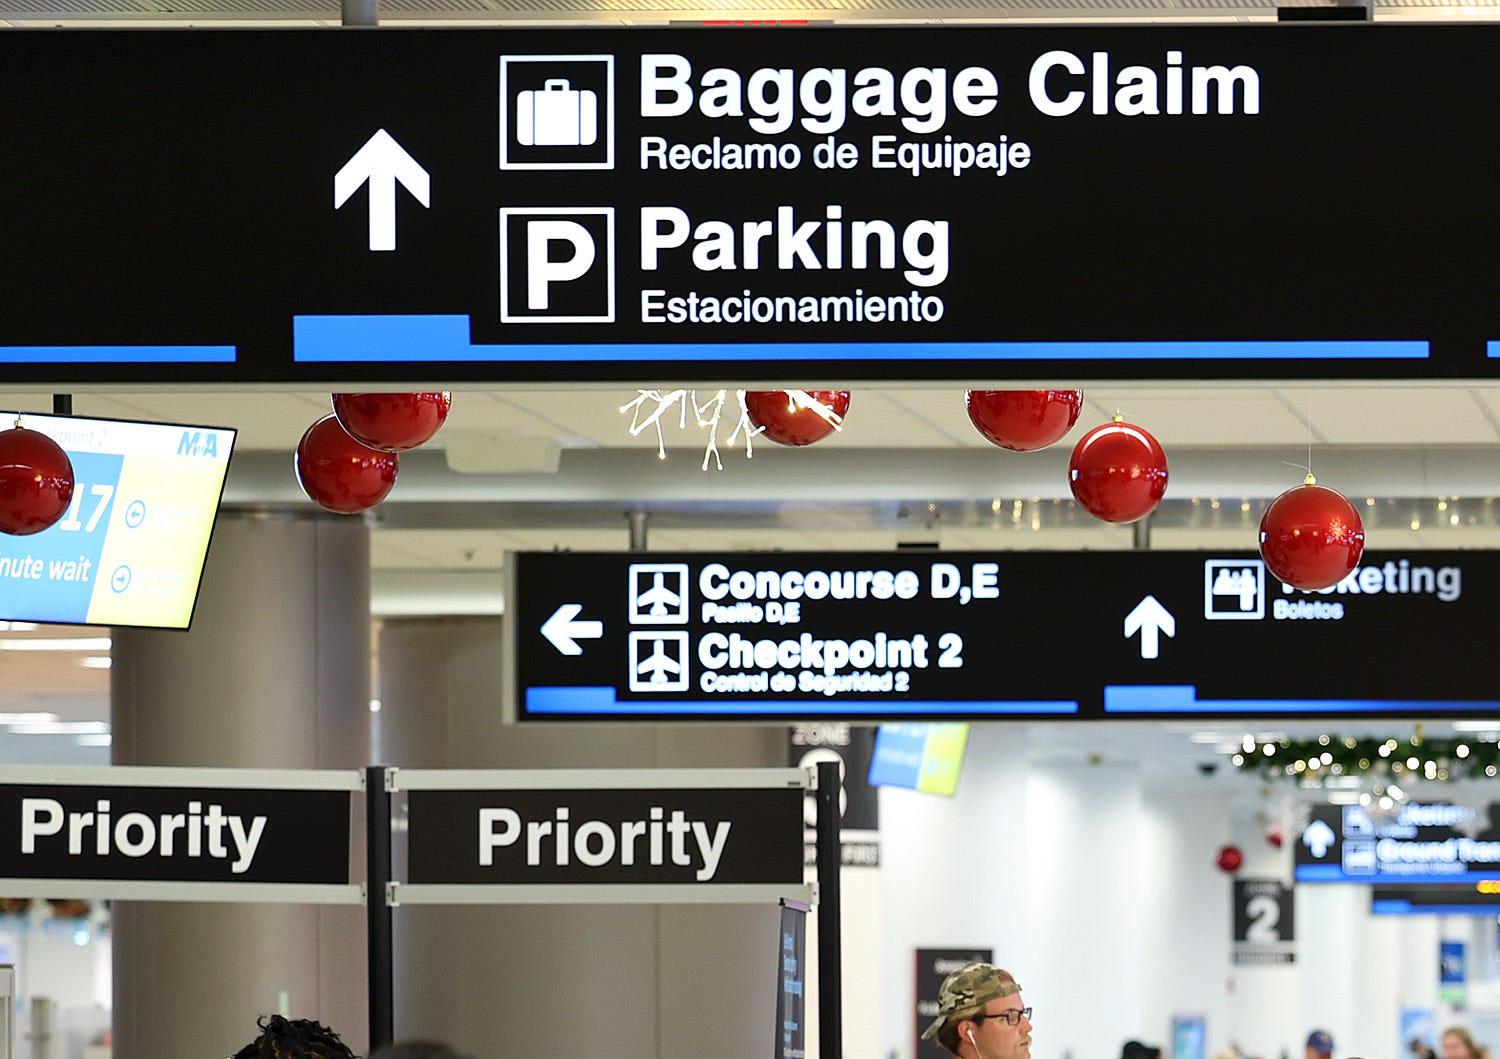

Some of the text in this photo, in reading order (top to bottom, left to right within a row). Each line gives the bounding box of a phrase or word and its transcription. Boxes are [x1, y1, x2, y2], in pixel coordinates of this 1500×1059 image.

[640, 50, 1261, 134] Baggage Claim
[640, 134, 1032, 177] Reclamo de Equipaje
[527, 220, 596, 310] P
[640, 205, 951, 287] Parking
[640, 288, 945, 323] Estacionamiento
[59, 483, 115, 533] 17
[0, 553, 92, 582] nute wait
[699, 563, 1000, 605] Concourse D,E
[1281, 558, 1462, 602] keting
[1273, 598, 1345, 620] Boletos
[698, 631, 964, 677] Checkpoint 2
[700, 671, 769, 693] Control
[769, 671, 797, 693] de
[894, 671, 911, 692] 2
[21, 798, 267, 874] Priority
[478, 807, 732, 881] Priority
[1246, 897, 1280, 942] 2
